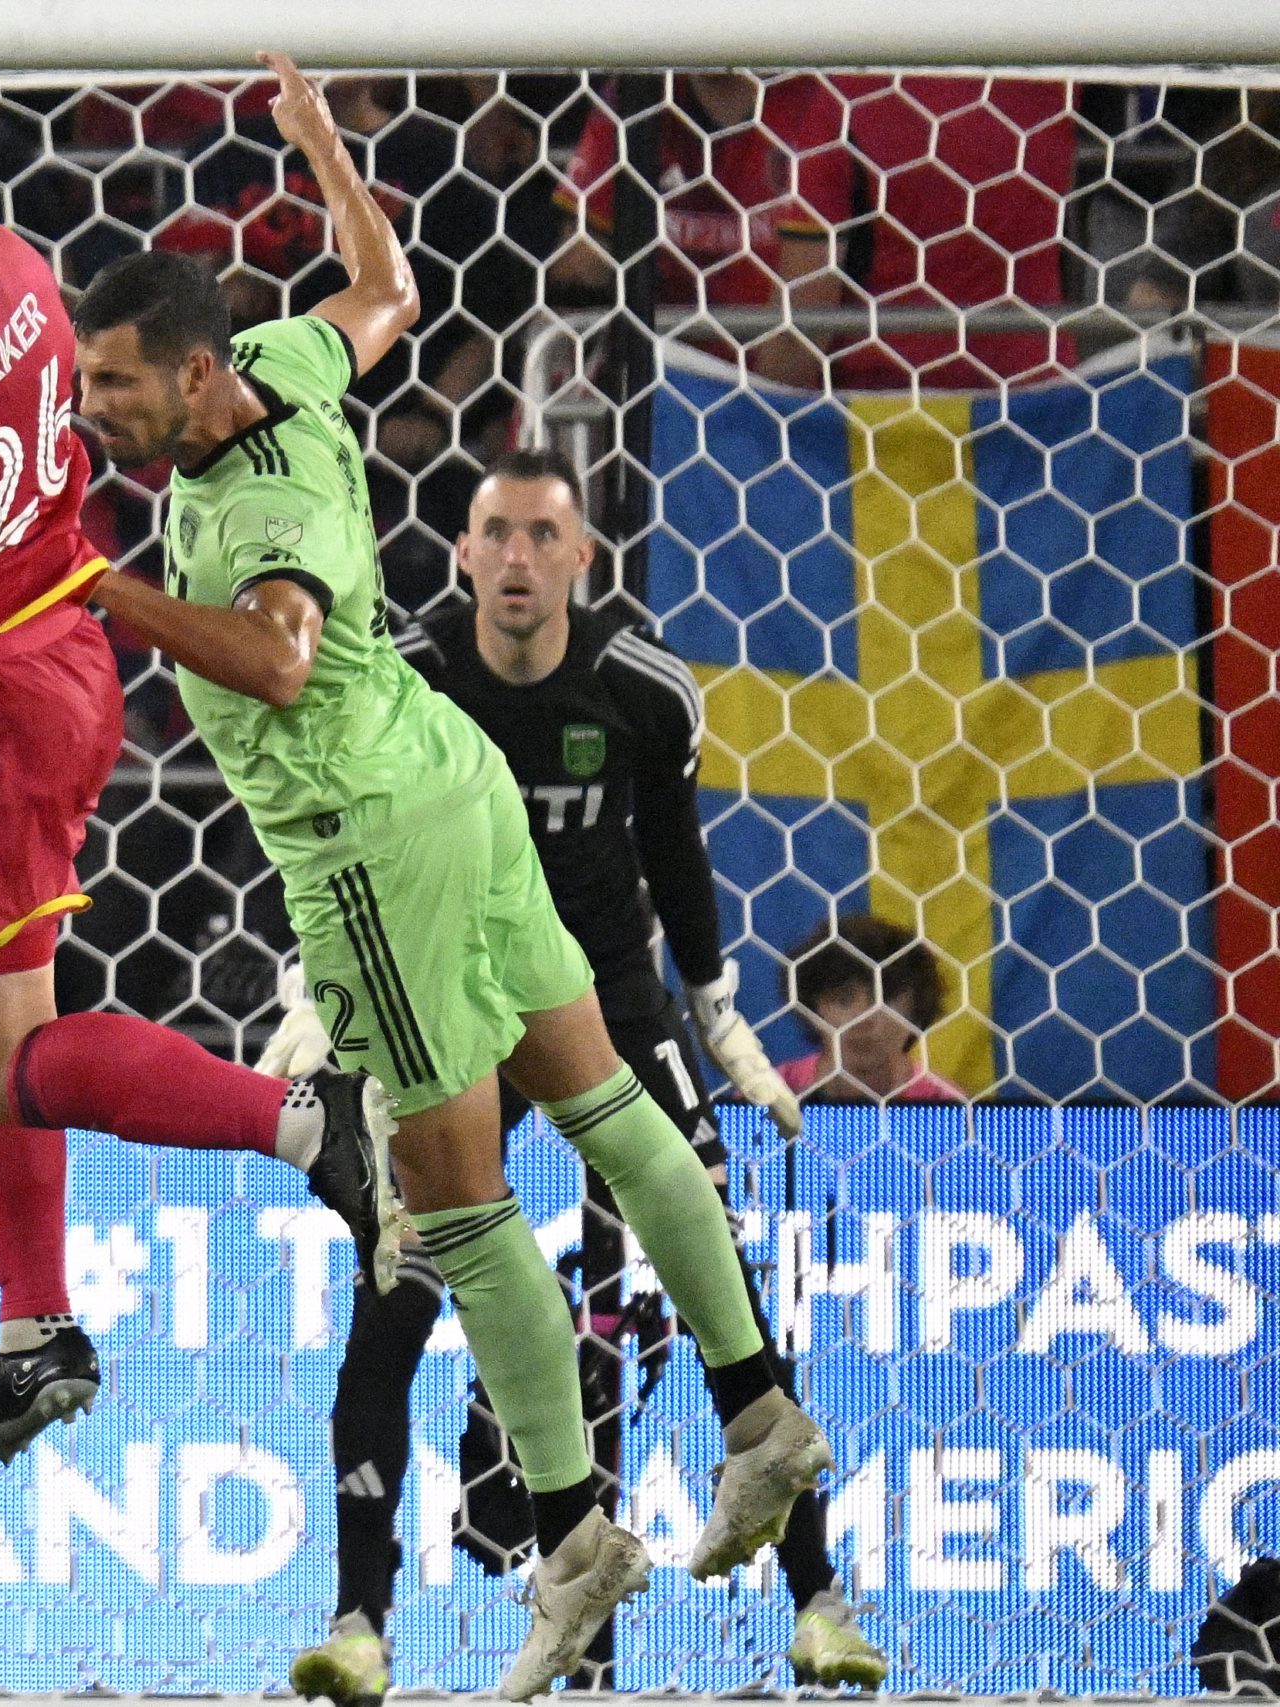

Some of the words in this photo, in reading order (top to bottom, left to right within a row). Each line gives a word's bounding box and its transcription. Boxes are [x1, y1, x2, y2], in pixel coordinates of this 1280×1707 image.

[520, 785, 604, 832] TI
[314, 979, 370, 1052] 2
[654, 1039, 700, 1112] 1
[63, 1207, 209, 1351] #1
